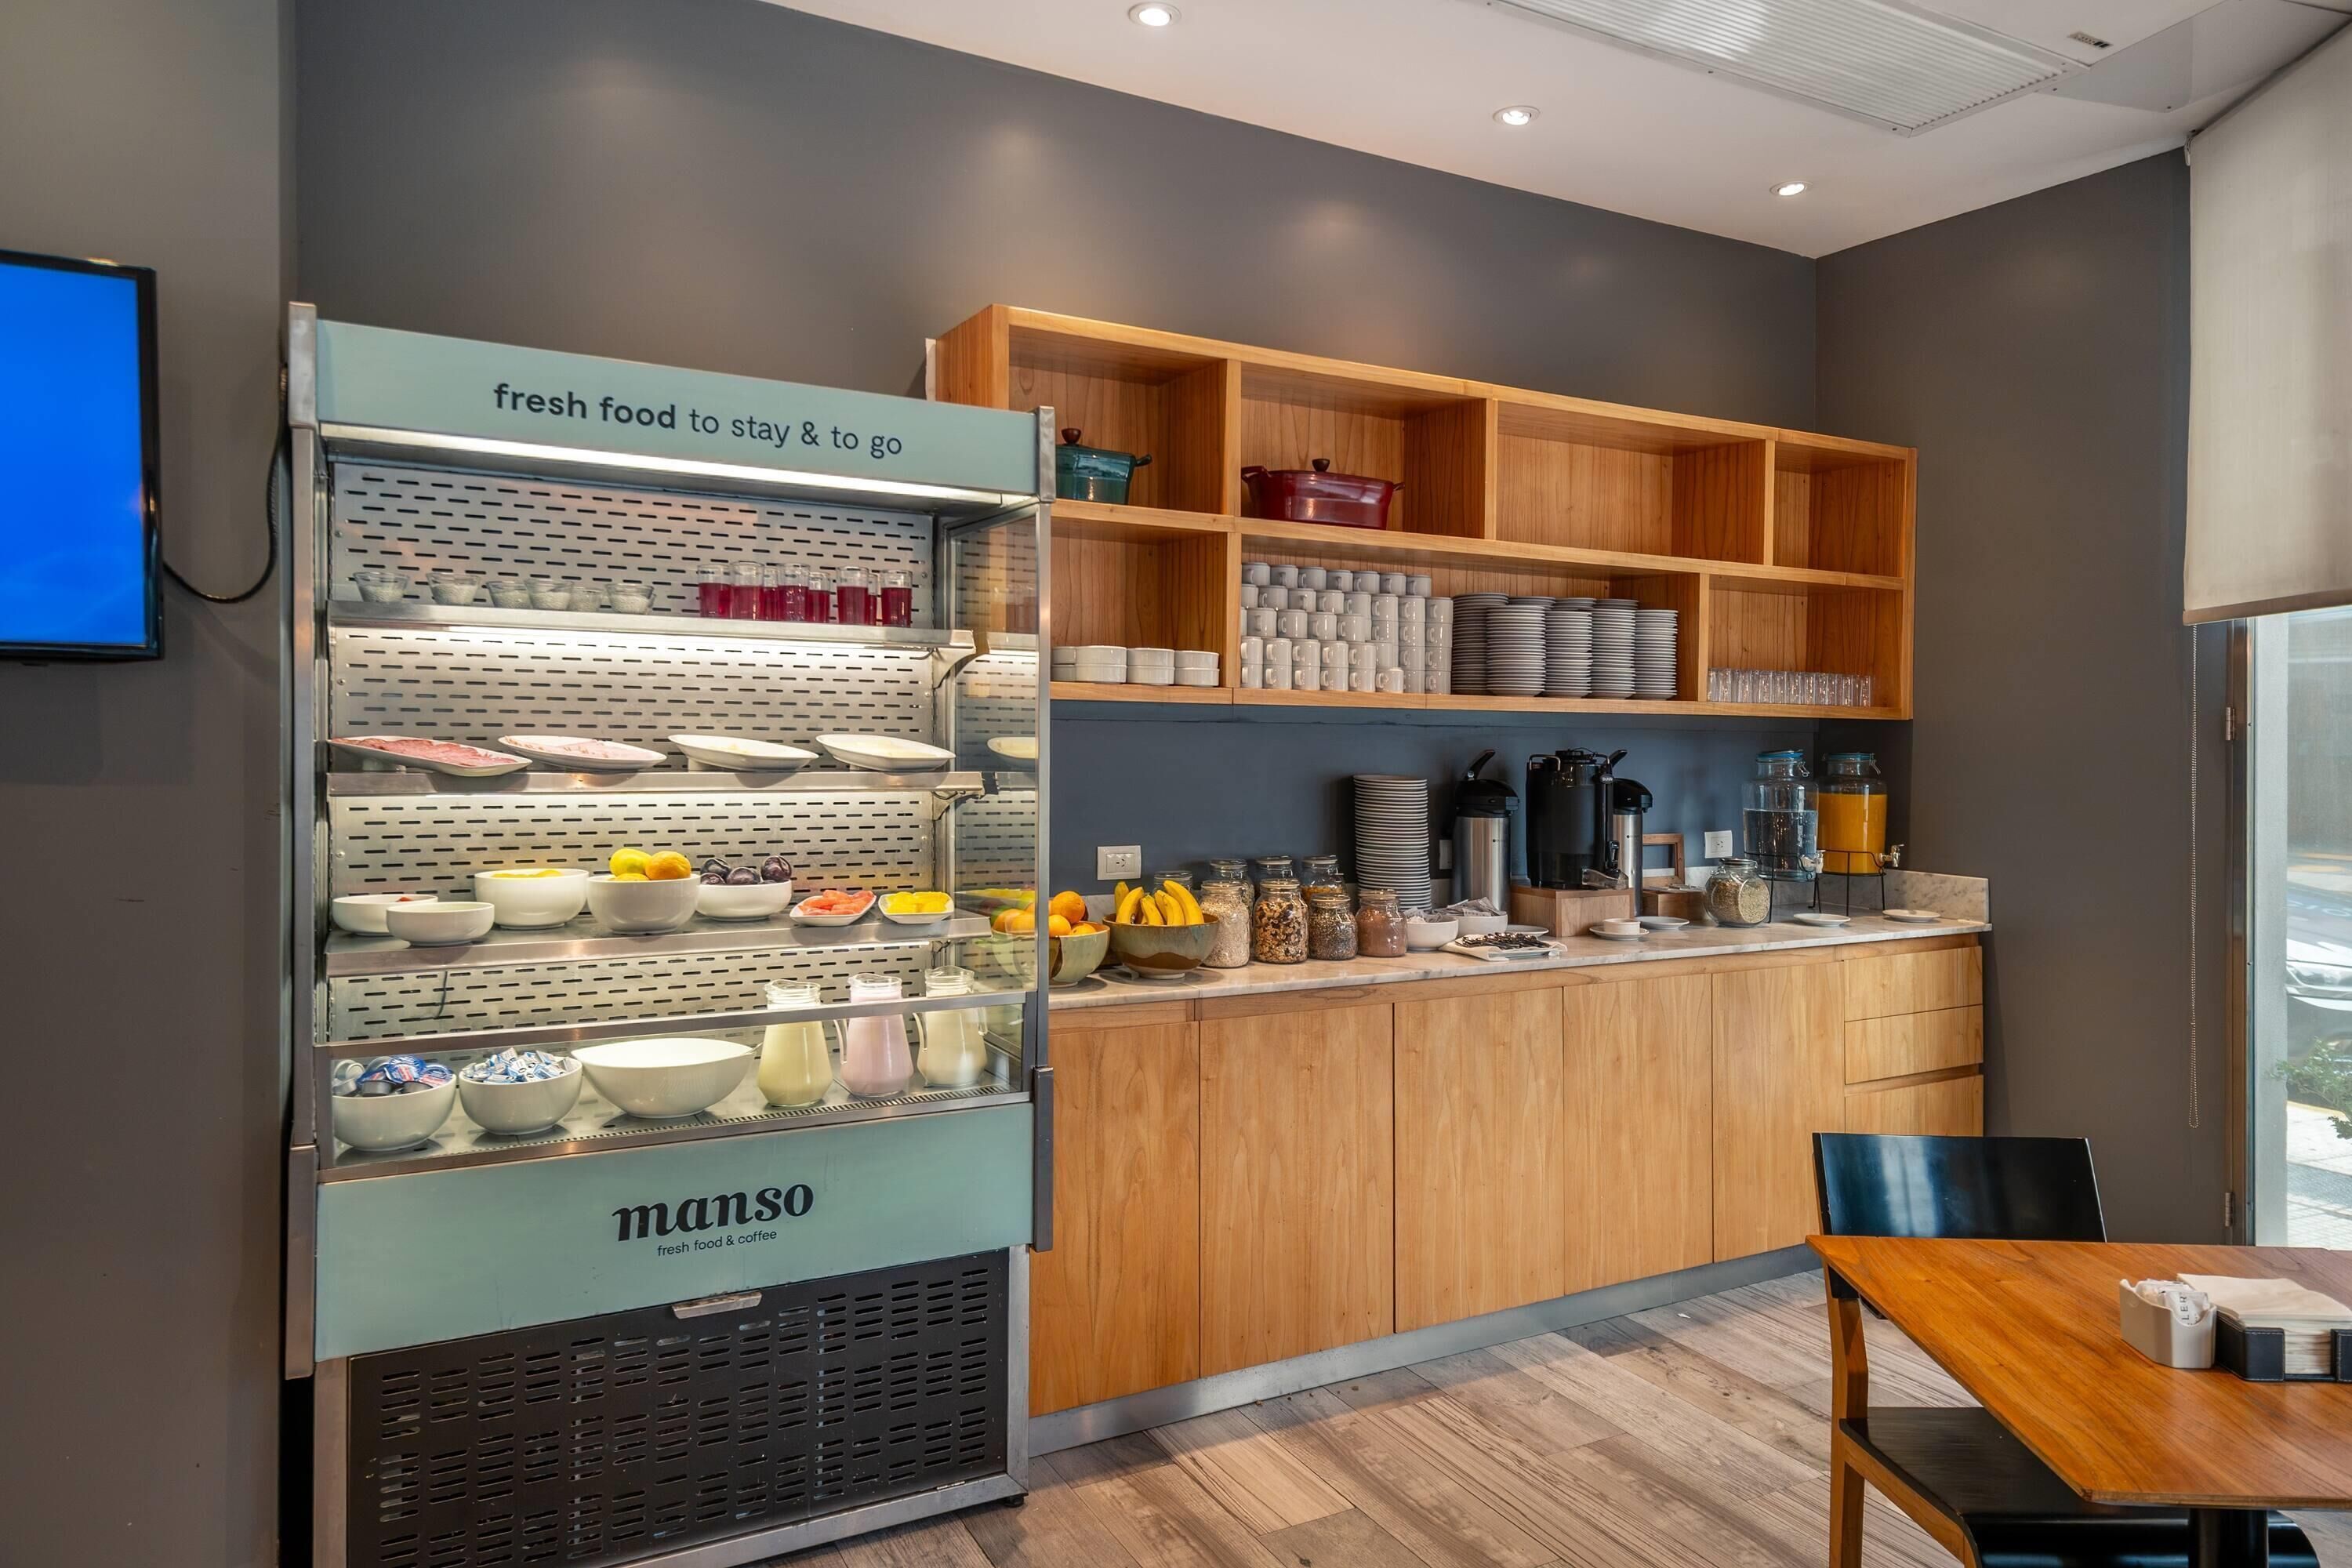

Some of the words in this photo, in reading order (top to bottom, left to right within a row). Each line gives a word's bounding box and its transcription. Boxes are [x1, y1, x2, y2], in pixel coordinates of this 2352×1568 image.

[493, 383, 587, 419] fresh
[598, 396, 676, 430] food
[688, 408, 720, 434] to
[731, 416, 791, 448] stay
[800, 420, 820, 447] &
[830, 426, 859, 450] to
[869, 435, 902, 459] go
[611, 1184, 814, 1242] manso
[657, 1242, 690, 1257] fresh
[694, 1236, 723, 1251] food
[725, 1235, 735, 1247] &
[738, 1229, 778, 1245] coffee
